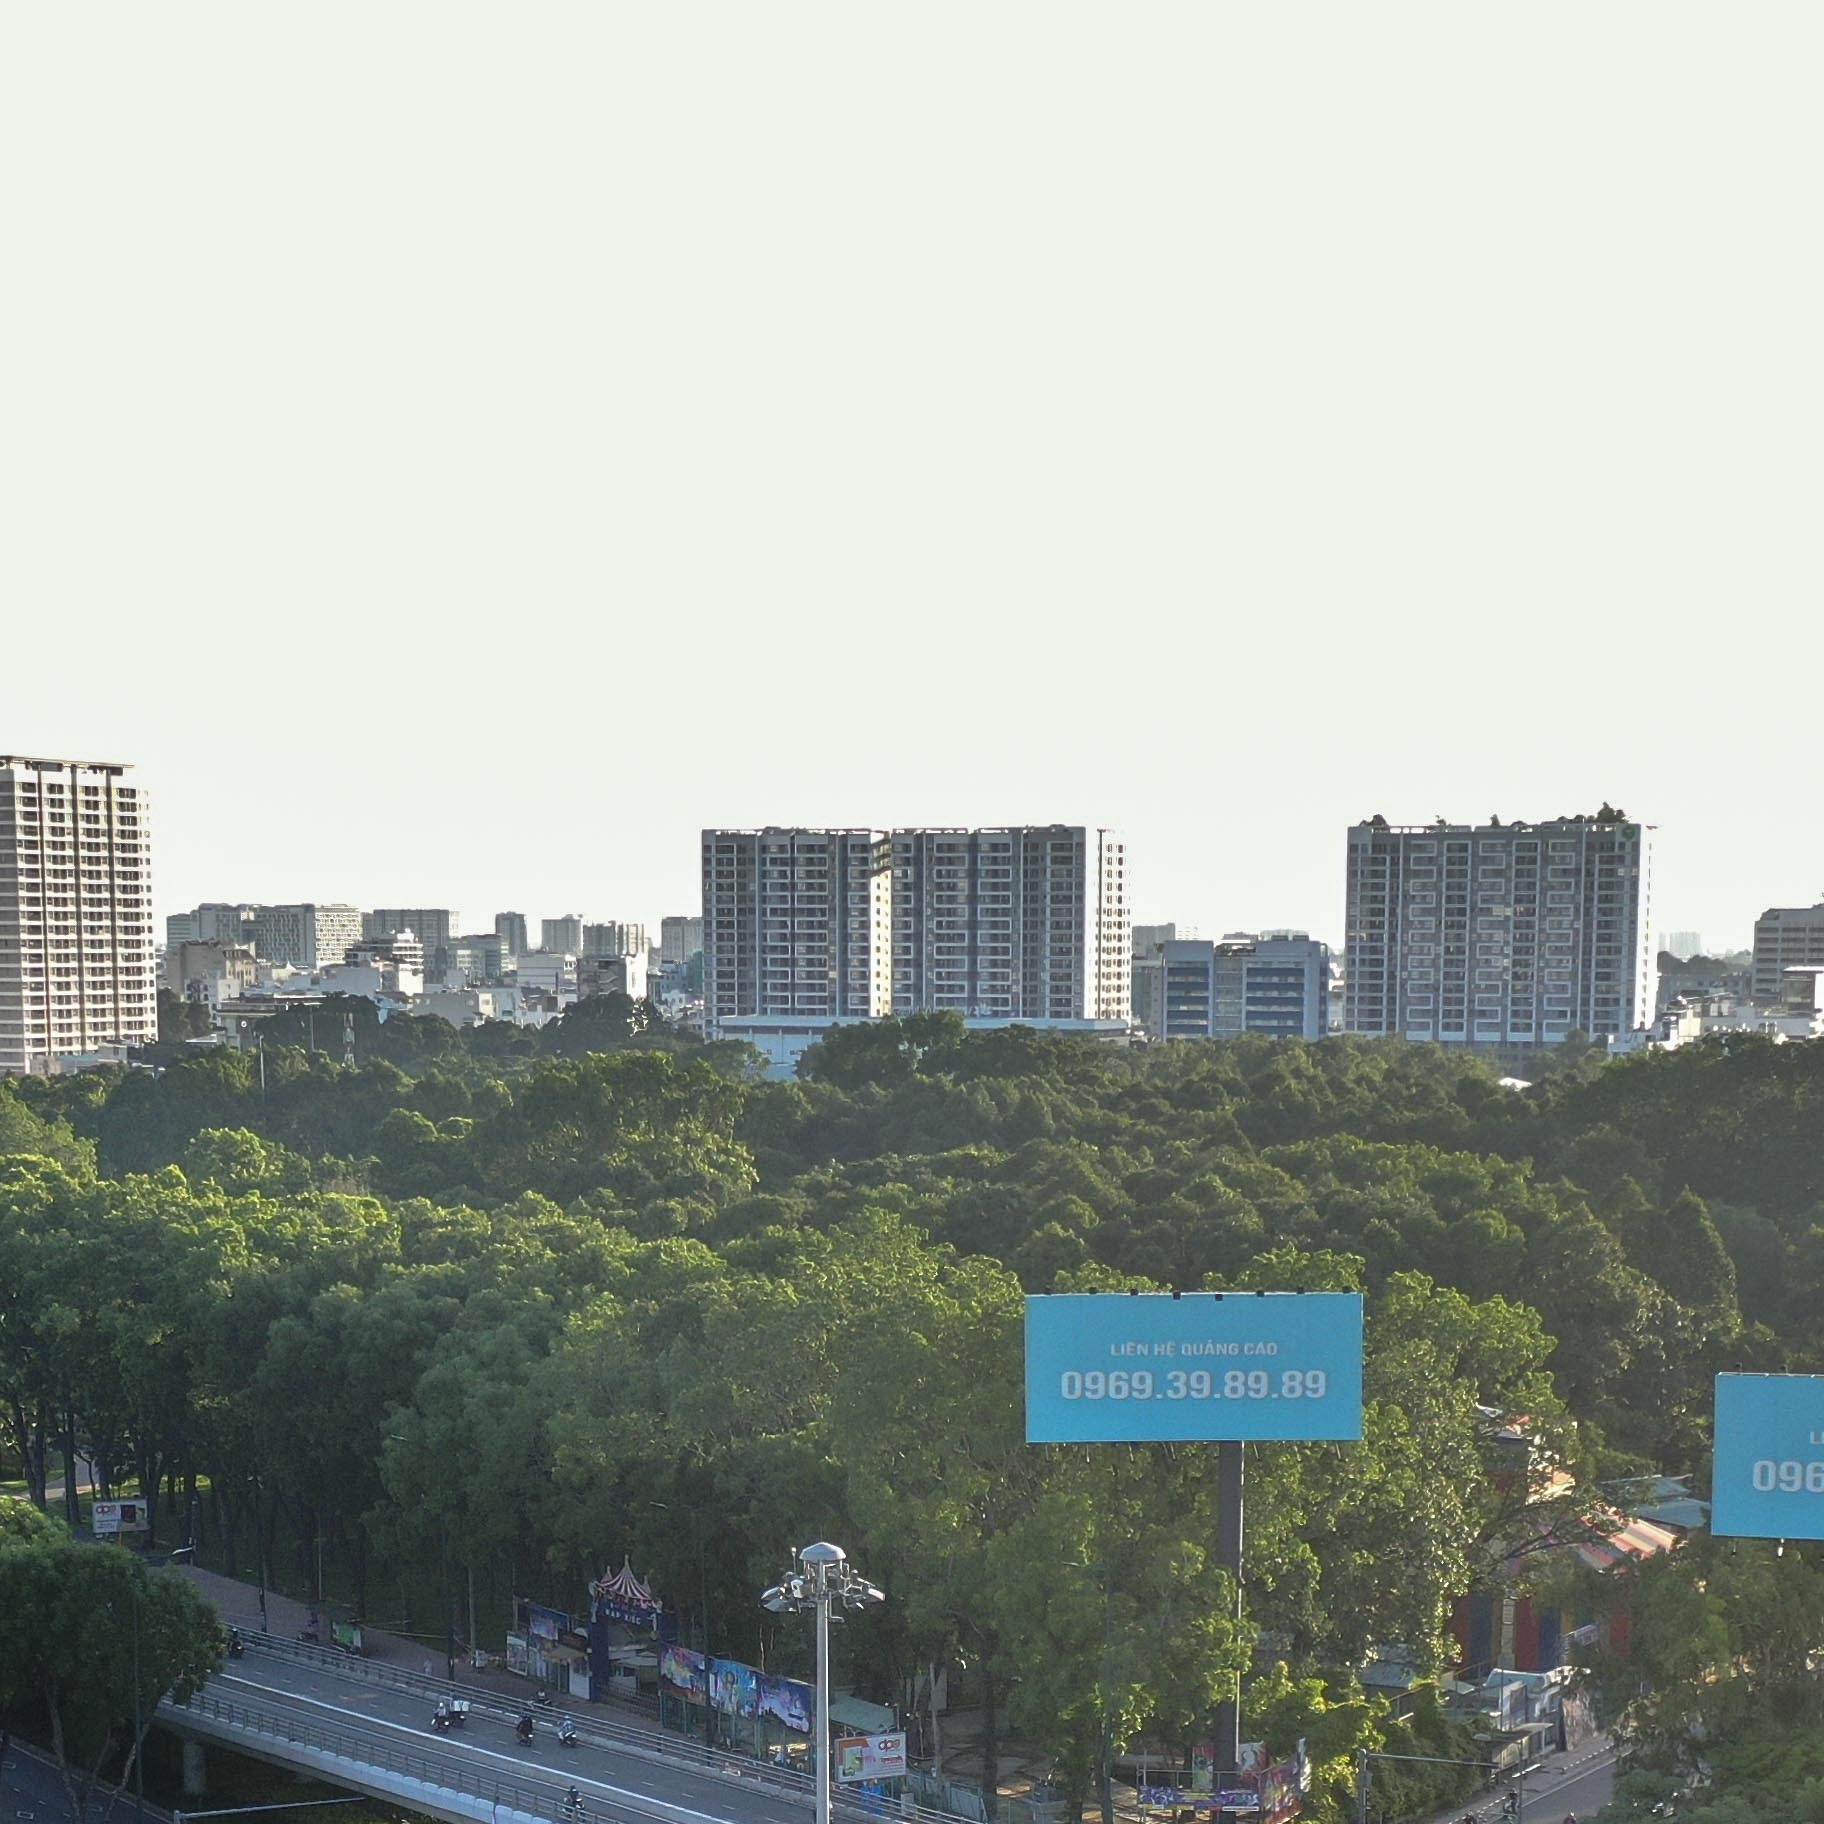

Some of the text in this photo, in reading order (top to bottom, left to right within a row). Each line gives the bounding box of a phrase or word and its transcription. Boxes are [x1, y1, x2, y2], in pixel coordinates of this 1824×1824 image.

[1111, 1342, 1278, 1357] LIÊN HỆ QUẢNG CÁO
[1061, 1369, 1327, 1400] 0969.39.89.89
